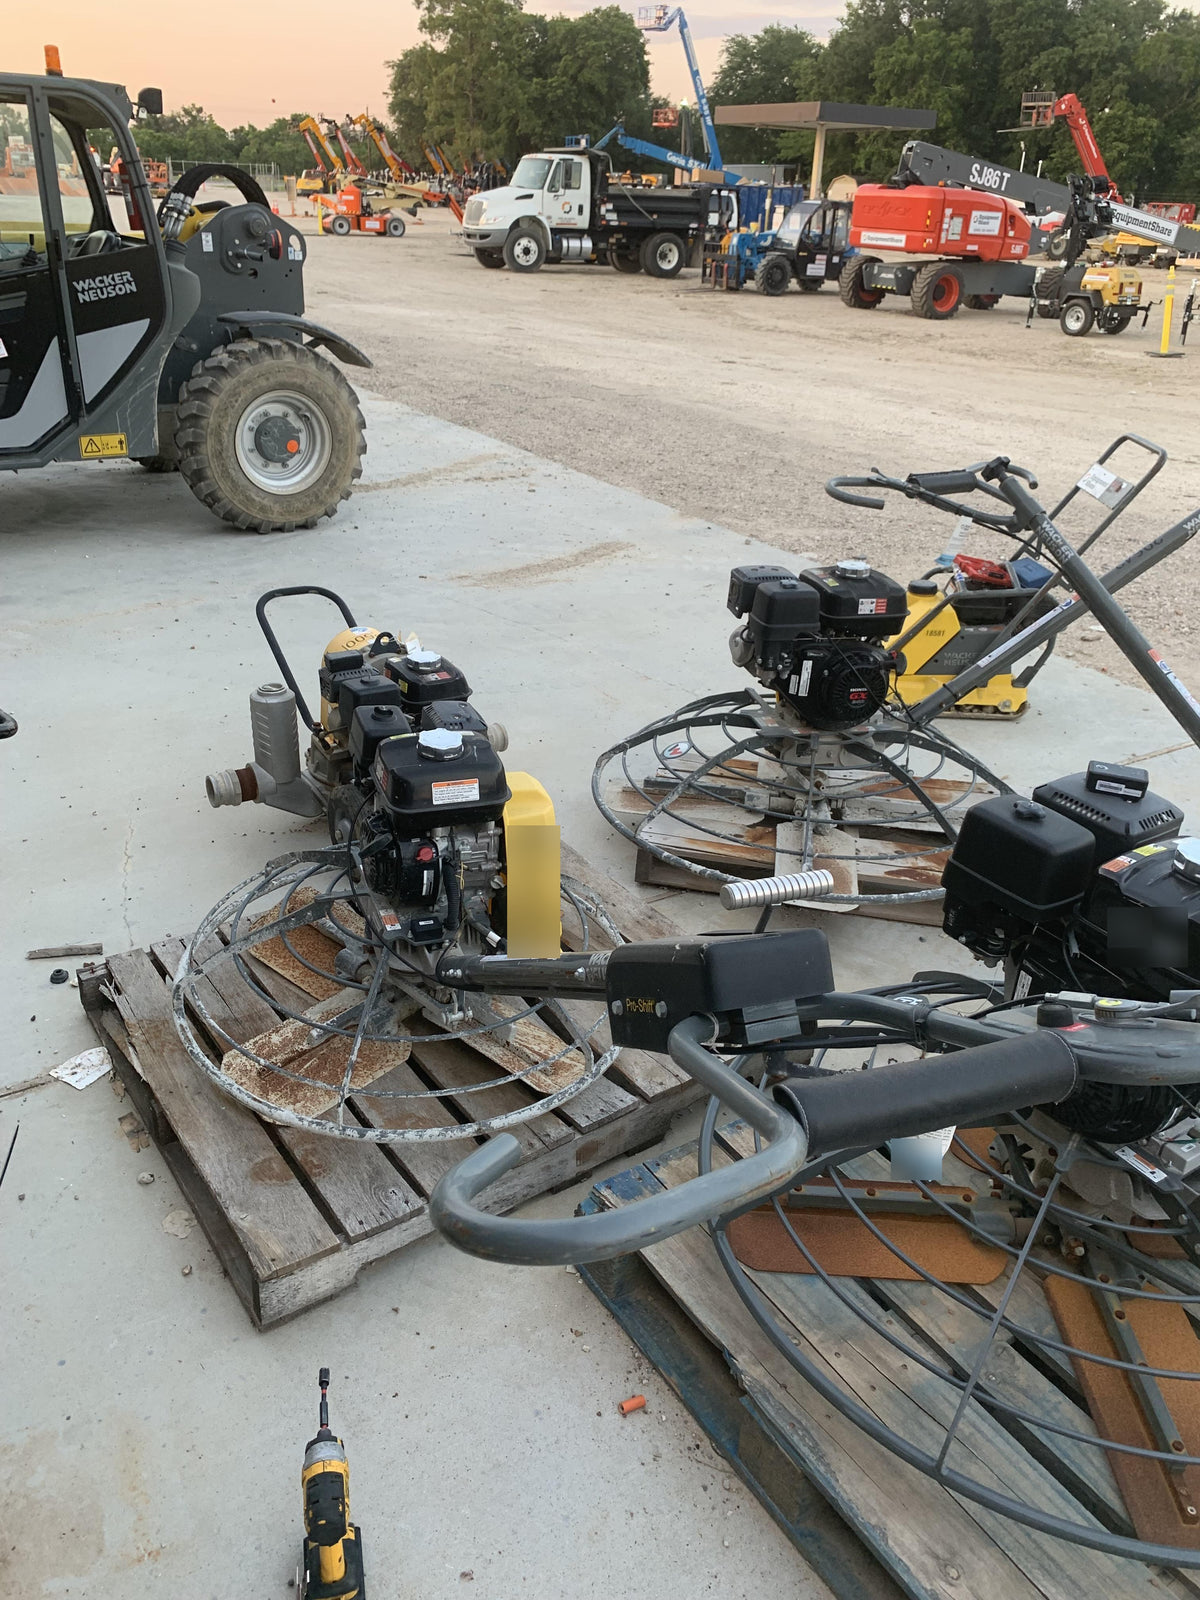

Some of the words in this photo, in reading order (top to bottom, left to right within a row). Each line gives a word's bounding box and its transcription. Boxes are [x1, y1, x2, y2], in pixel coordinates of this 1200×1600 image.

[666, 152, 686, 166] Genie
[687, 158, 707, 170] SX-1
[73, 270, 134, 293] WACKER
[78, 281, 137, 303] NEUSON
[1042, 520, 1074, 558] WACKER
[943, 651, 977, 659] WACKE
